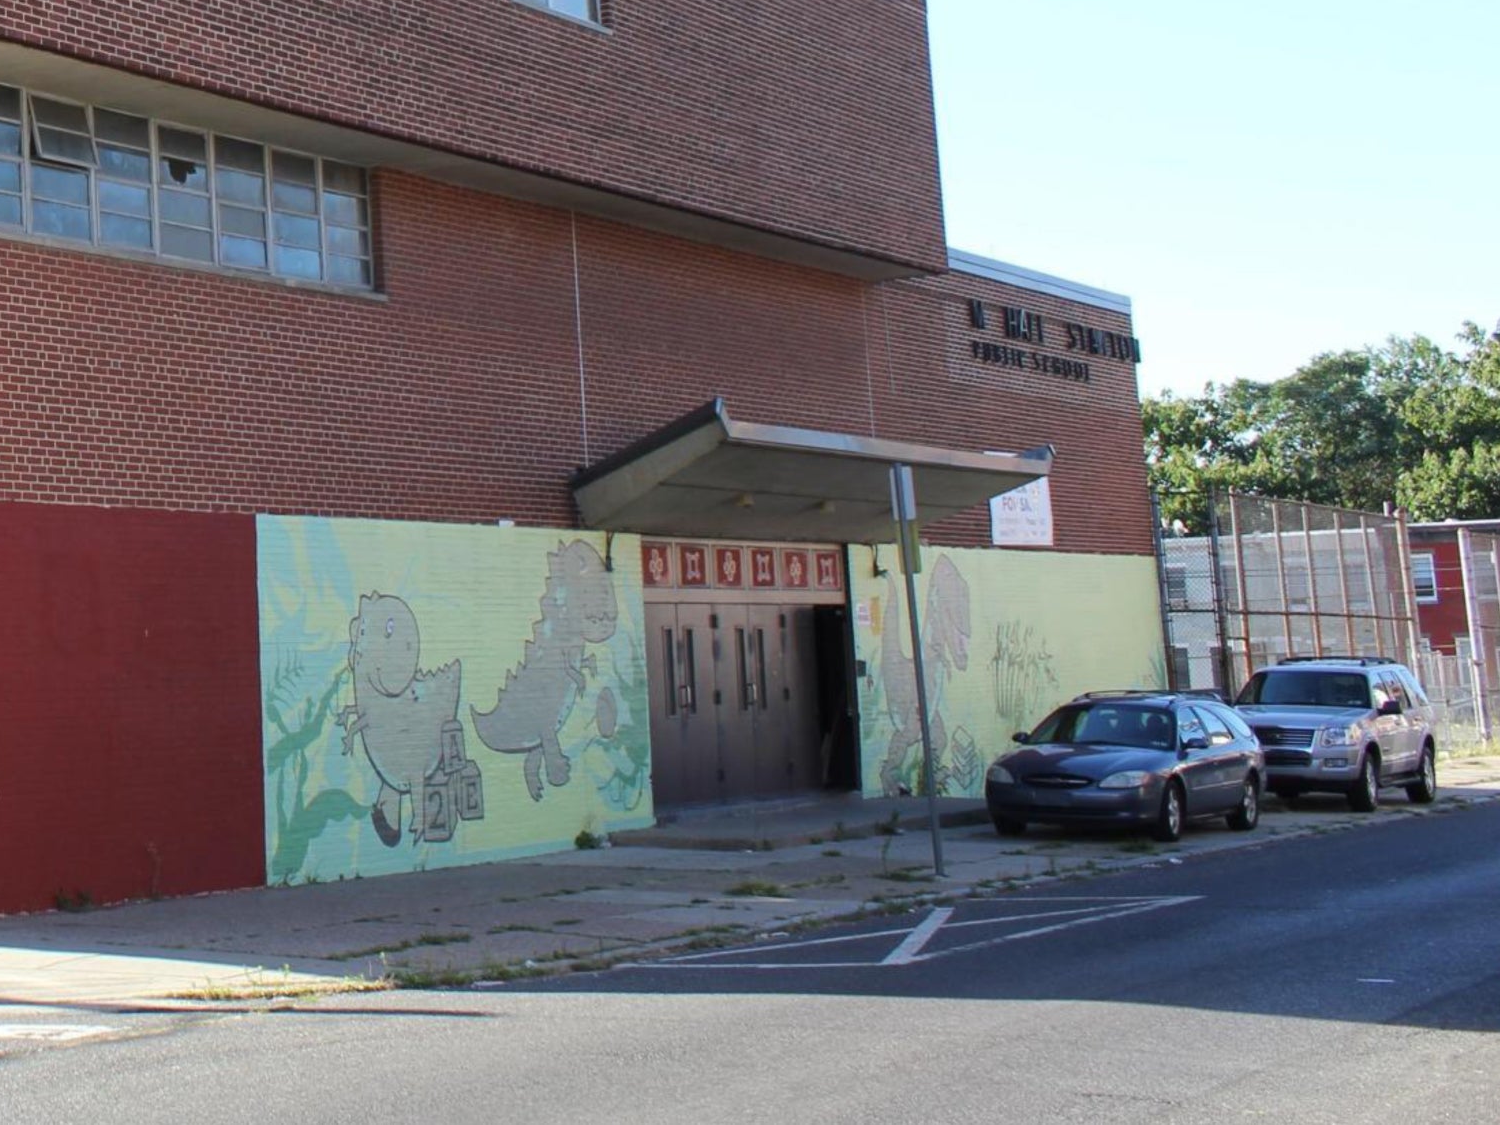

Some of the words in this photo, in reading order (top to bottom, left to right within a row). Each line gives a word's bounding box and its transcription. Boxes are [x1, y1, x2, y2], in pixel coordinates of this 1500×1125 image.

[973, 340, 1026, 369] PUBLIC
[1031, 352, 1089, 381] SCHOOL
[449, 733, 462, 766] A
[428, 790, 446, 830] 2
